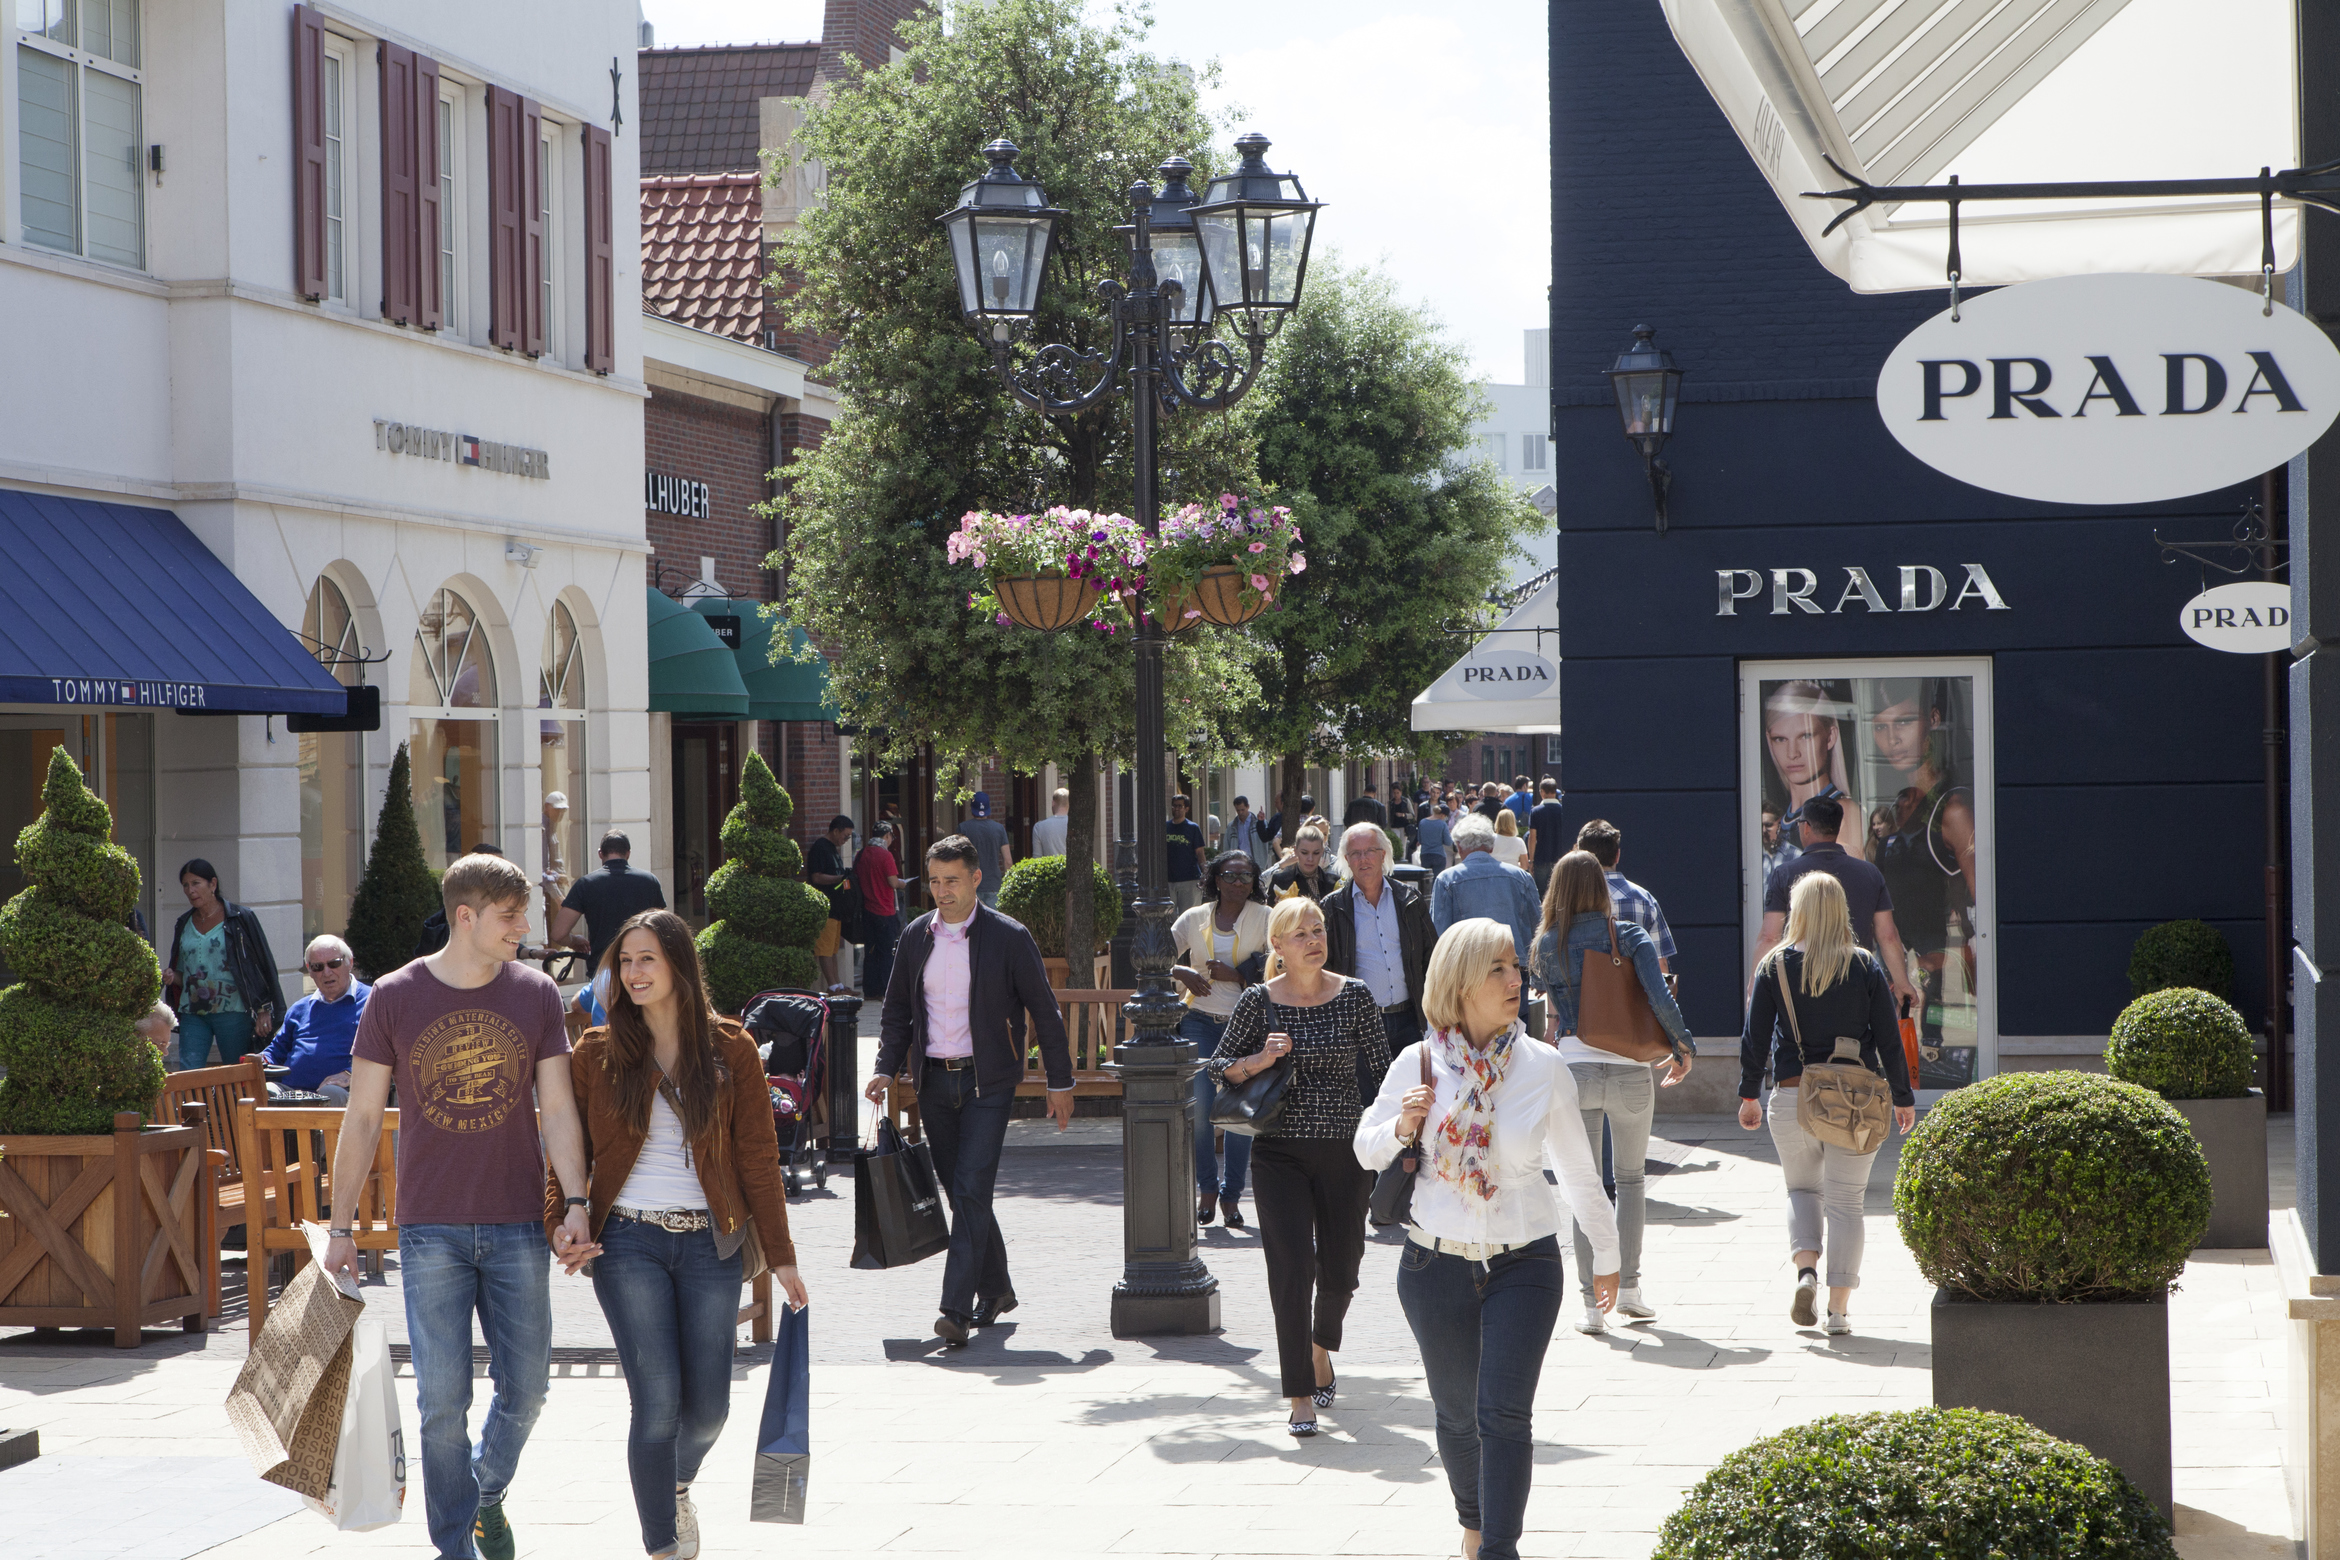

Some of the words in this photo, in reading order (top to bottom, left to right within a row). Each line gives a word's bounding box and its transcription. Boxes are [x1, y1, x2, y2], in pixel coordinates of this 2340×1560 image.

[1916, 351, 2309, 421] PRADA
[373, 419, 454, 463] TOMMY
[479, 439, 550, 480] HILFIGER
[1715, 563, 2012, 616] PRADA
[52, 679, 117, 703] TOMMY
[140, 682, 206, 707] HILFIGER
[1464, 665, 1549, 683] PRADA
[412, 1021, 446, 1066] BUILDING
[448, 1012, 508, 1031] MATERIALS
[425, 1105, 454, 1127] NEW
[457, 1103, 508, 1131] MEXICO
